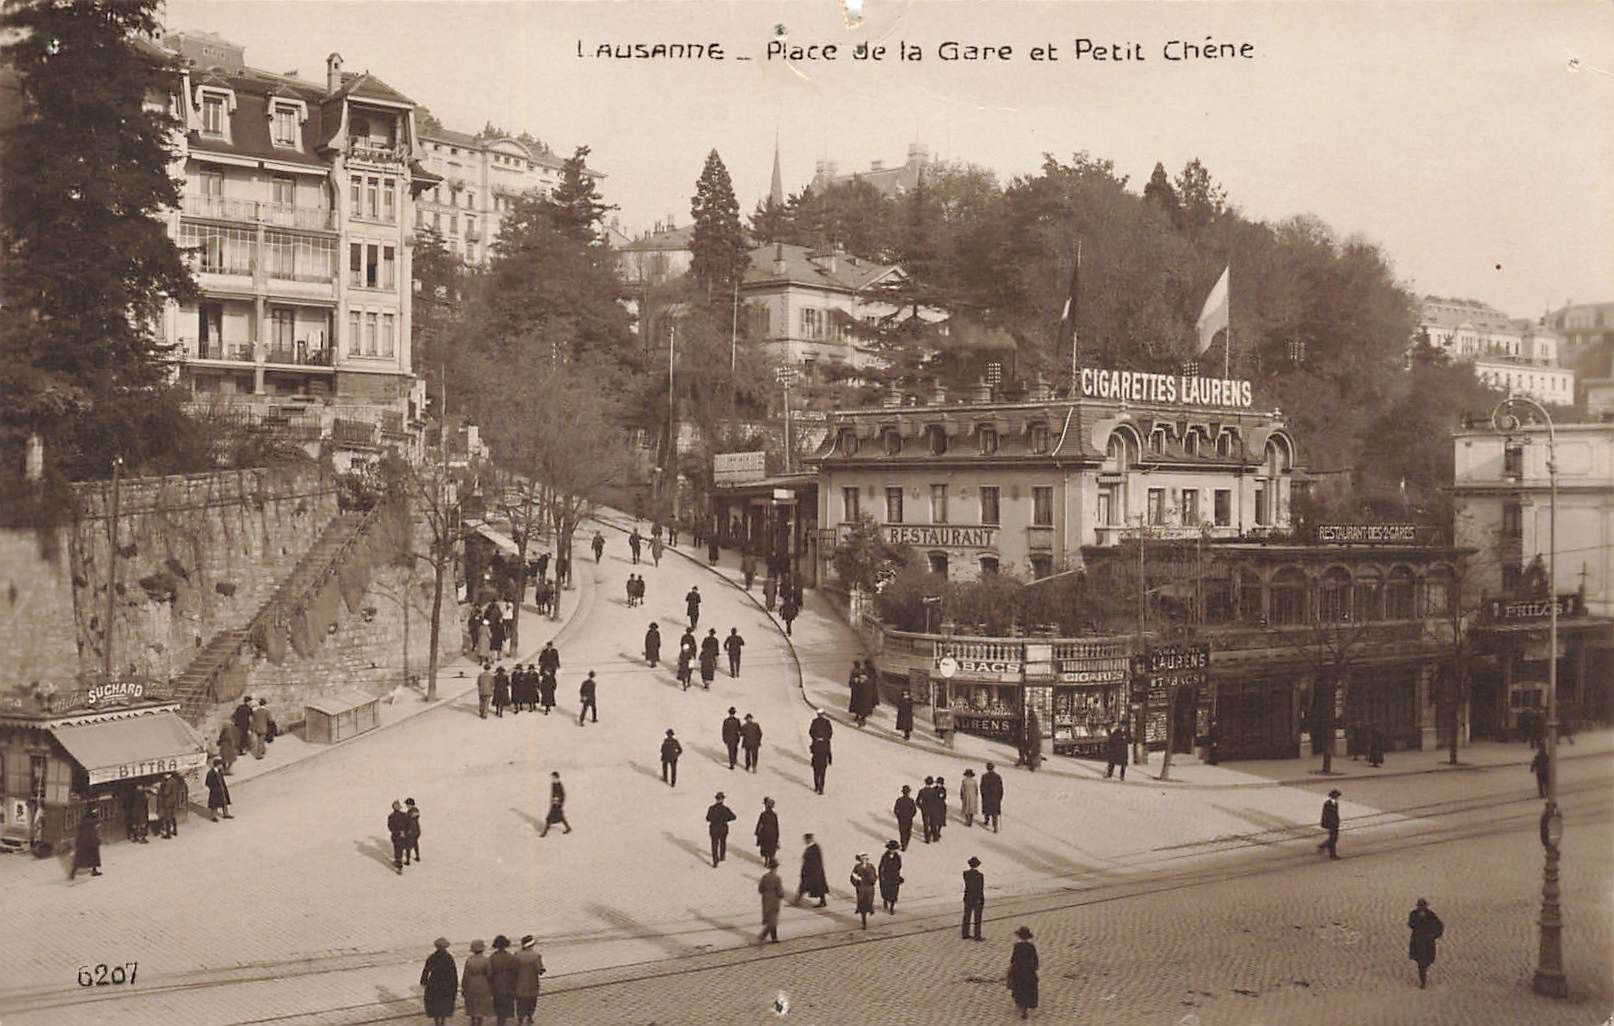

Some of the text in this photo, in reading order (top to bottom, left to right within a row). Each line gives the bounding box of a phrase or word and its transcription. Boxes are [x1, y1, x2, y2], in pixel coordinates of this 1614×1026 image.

[1081, 367, 1252, 407] CIGARETTES LAURENS
[890, 528, 994, 546] RESTAURANT
[1063, 671, 1125, 682] CIGARES
[88, 682, 144, 704] SUCHARD
[118, 759, 178, 778] BITTRA
